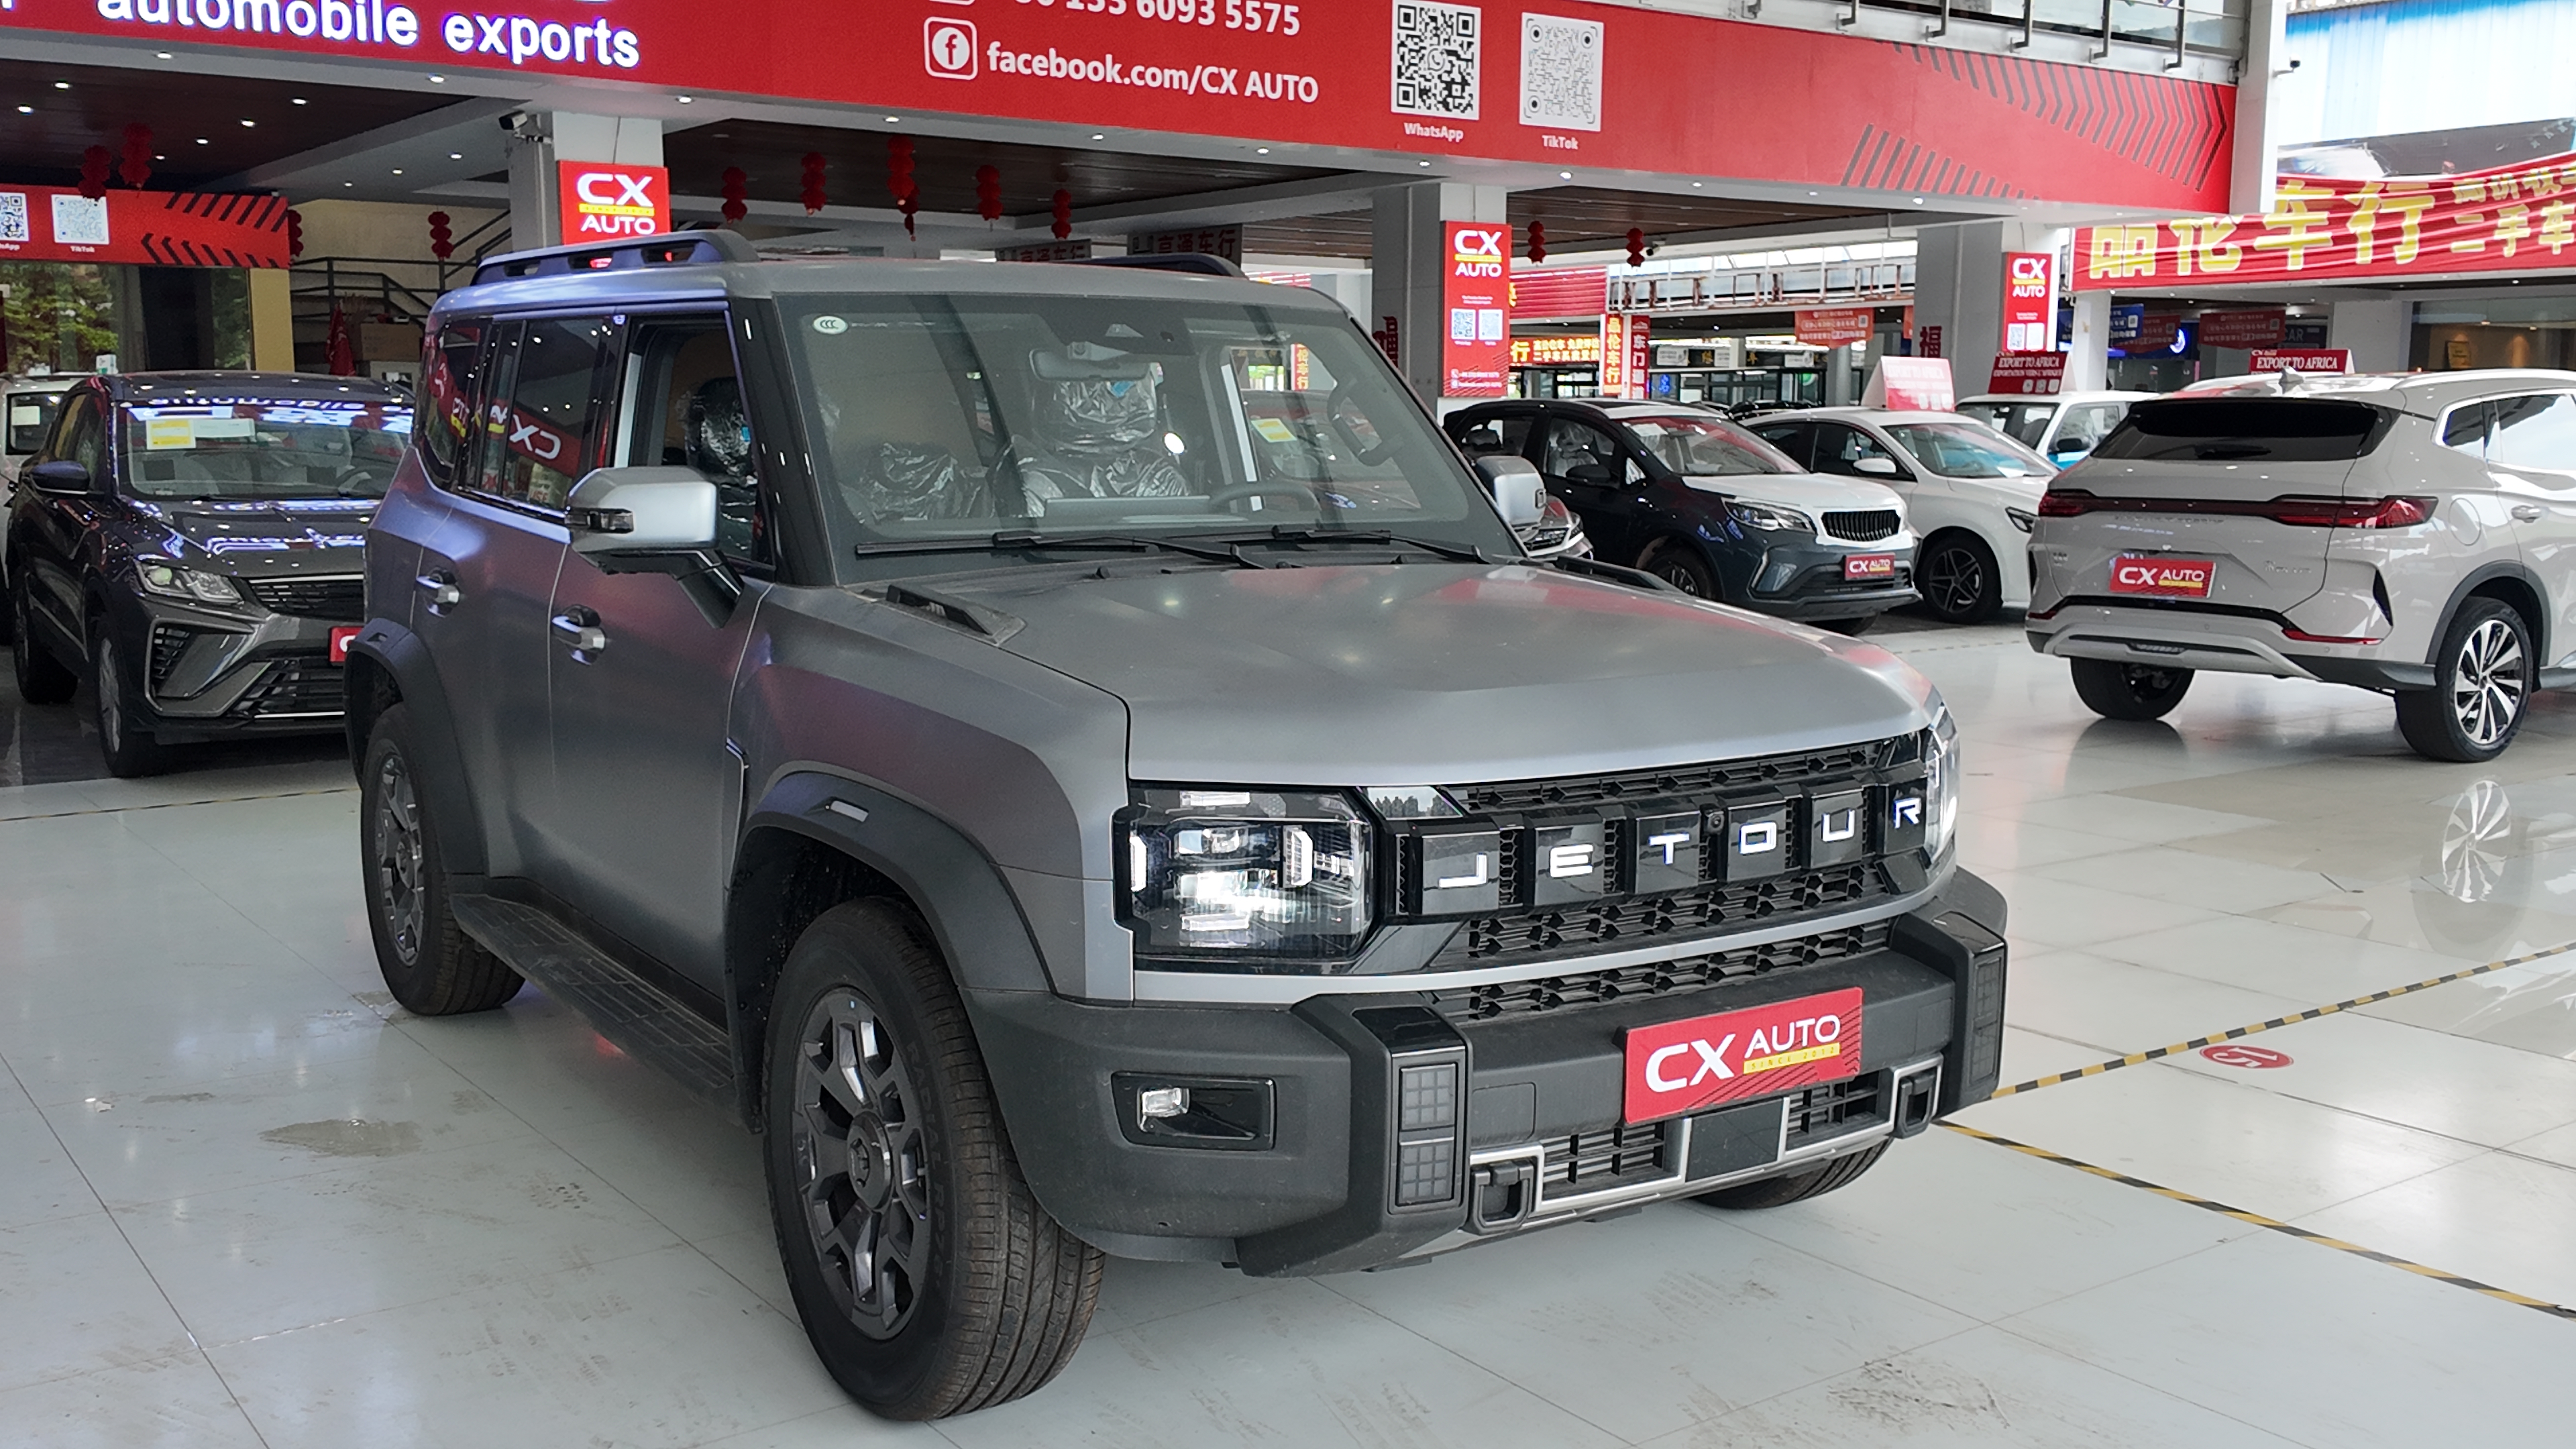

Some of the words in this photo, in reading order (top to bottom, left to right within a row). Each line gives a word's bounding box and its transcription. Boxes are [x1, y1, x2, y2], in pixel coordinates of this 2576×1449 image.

[1136, 0, 1216, 25] 6093
[1225, 0, 1300, 36] 5575
[443, 13, 639, 68] exports
[987, 41, 1238, 95] facebook.com/CX
[1244, 71, 1318, 103] AUTO
[1404, 122, 1464, 142] WhatsApp
[1542, 135, 1578, 150] TikTok
[577, 172, 654, 207] CX
[580, 214, 655, 235] AUTO
[1454, 229, 1502, 256] CX
[1455, 262, 1502, 278] AUTO
[2012, 258, 2046, 278] CX
[2012, 286, 2045, 298] AUTO
[2305, 356, 2338, 369] AFRICA
[1849, 560, 1868, 573] CX
[2118, 567, 2158, 586] CX
[2159, 569, 2204, 582] AUTO
[1438, 796, 1921, 889] JETOUR
[1646, 1033, 1736, 1093] CX
[1744, 1014, 1841, 1059] AUTO
[1751, 1055, 1792, 1070] SINCE
[1803, 1046, 1836, 1060] 2012
